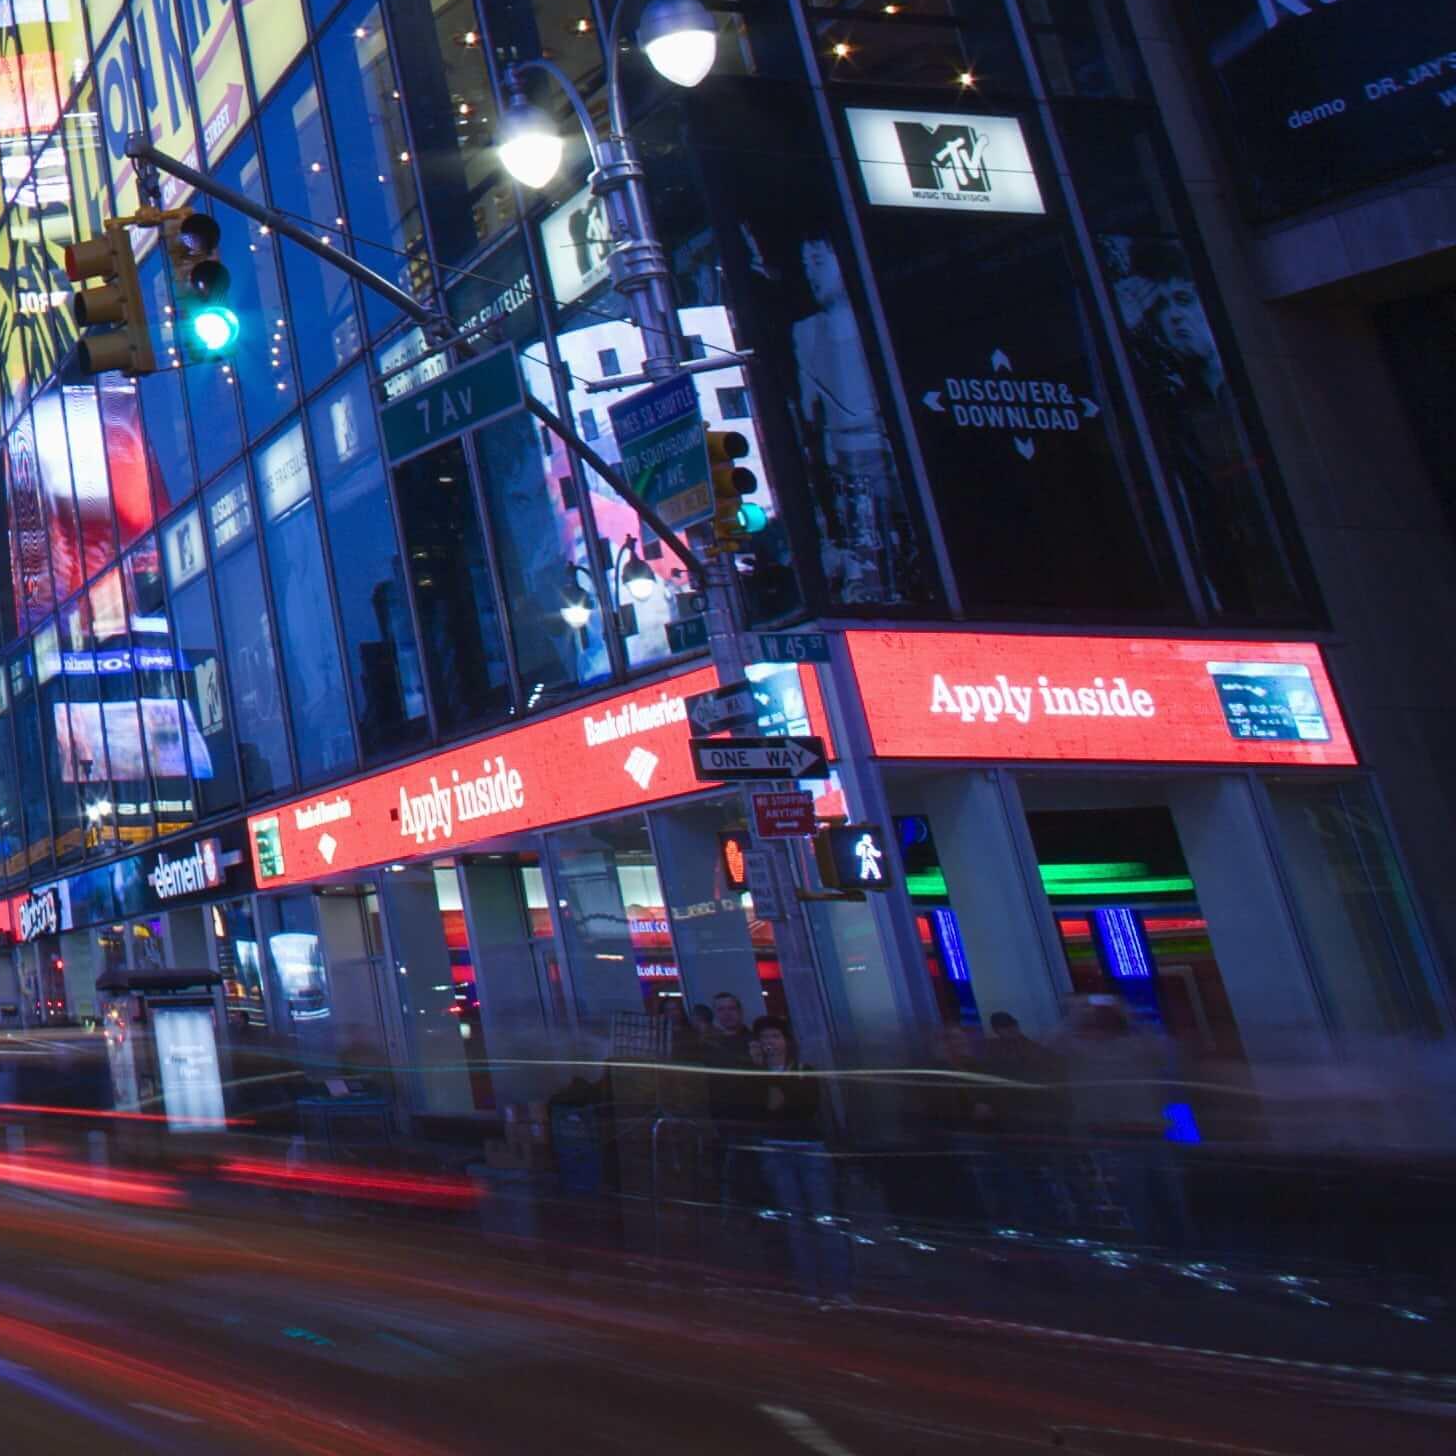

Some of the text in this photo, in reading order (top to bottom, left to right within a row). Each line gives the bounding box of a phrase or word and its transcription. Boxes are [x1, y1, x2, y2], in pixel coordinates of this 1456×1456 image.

[1288, 99, 1345, 129] demo
[1364, 77, 1405, 100] DR.
[893, 121, 992, 193] MTV
[913, 191, 991, 203] MUSIC TELEVISION
[416, 400, 431, 433] 7
[953, 405, 1079, 431] DOWNLOAD
[786, 638, 806, 658] 45
[930, 673, 1155, 723] Apply inside
[711, 751, 806, 767] ONE WAY
[399, 756, 524, 844] Apply inside
[766, 808, 805, 818] ANYTIME
[154, 842, 203, 899] element
